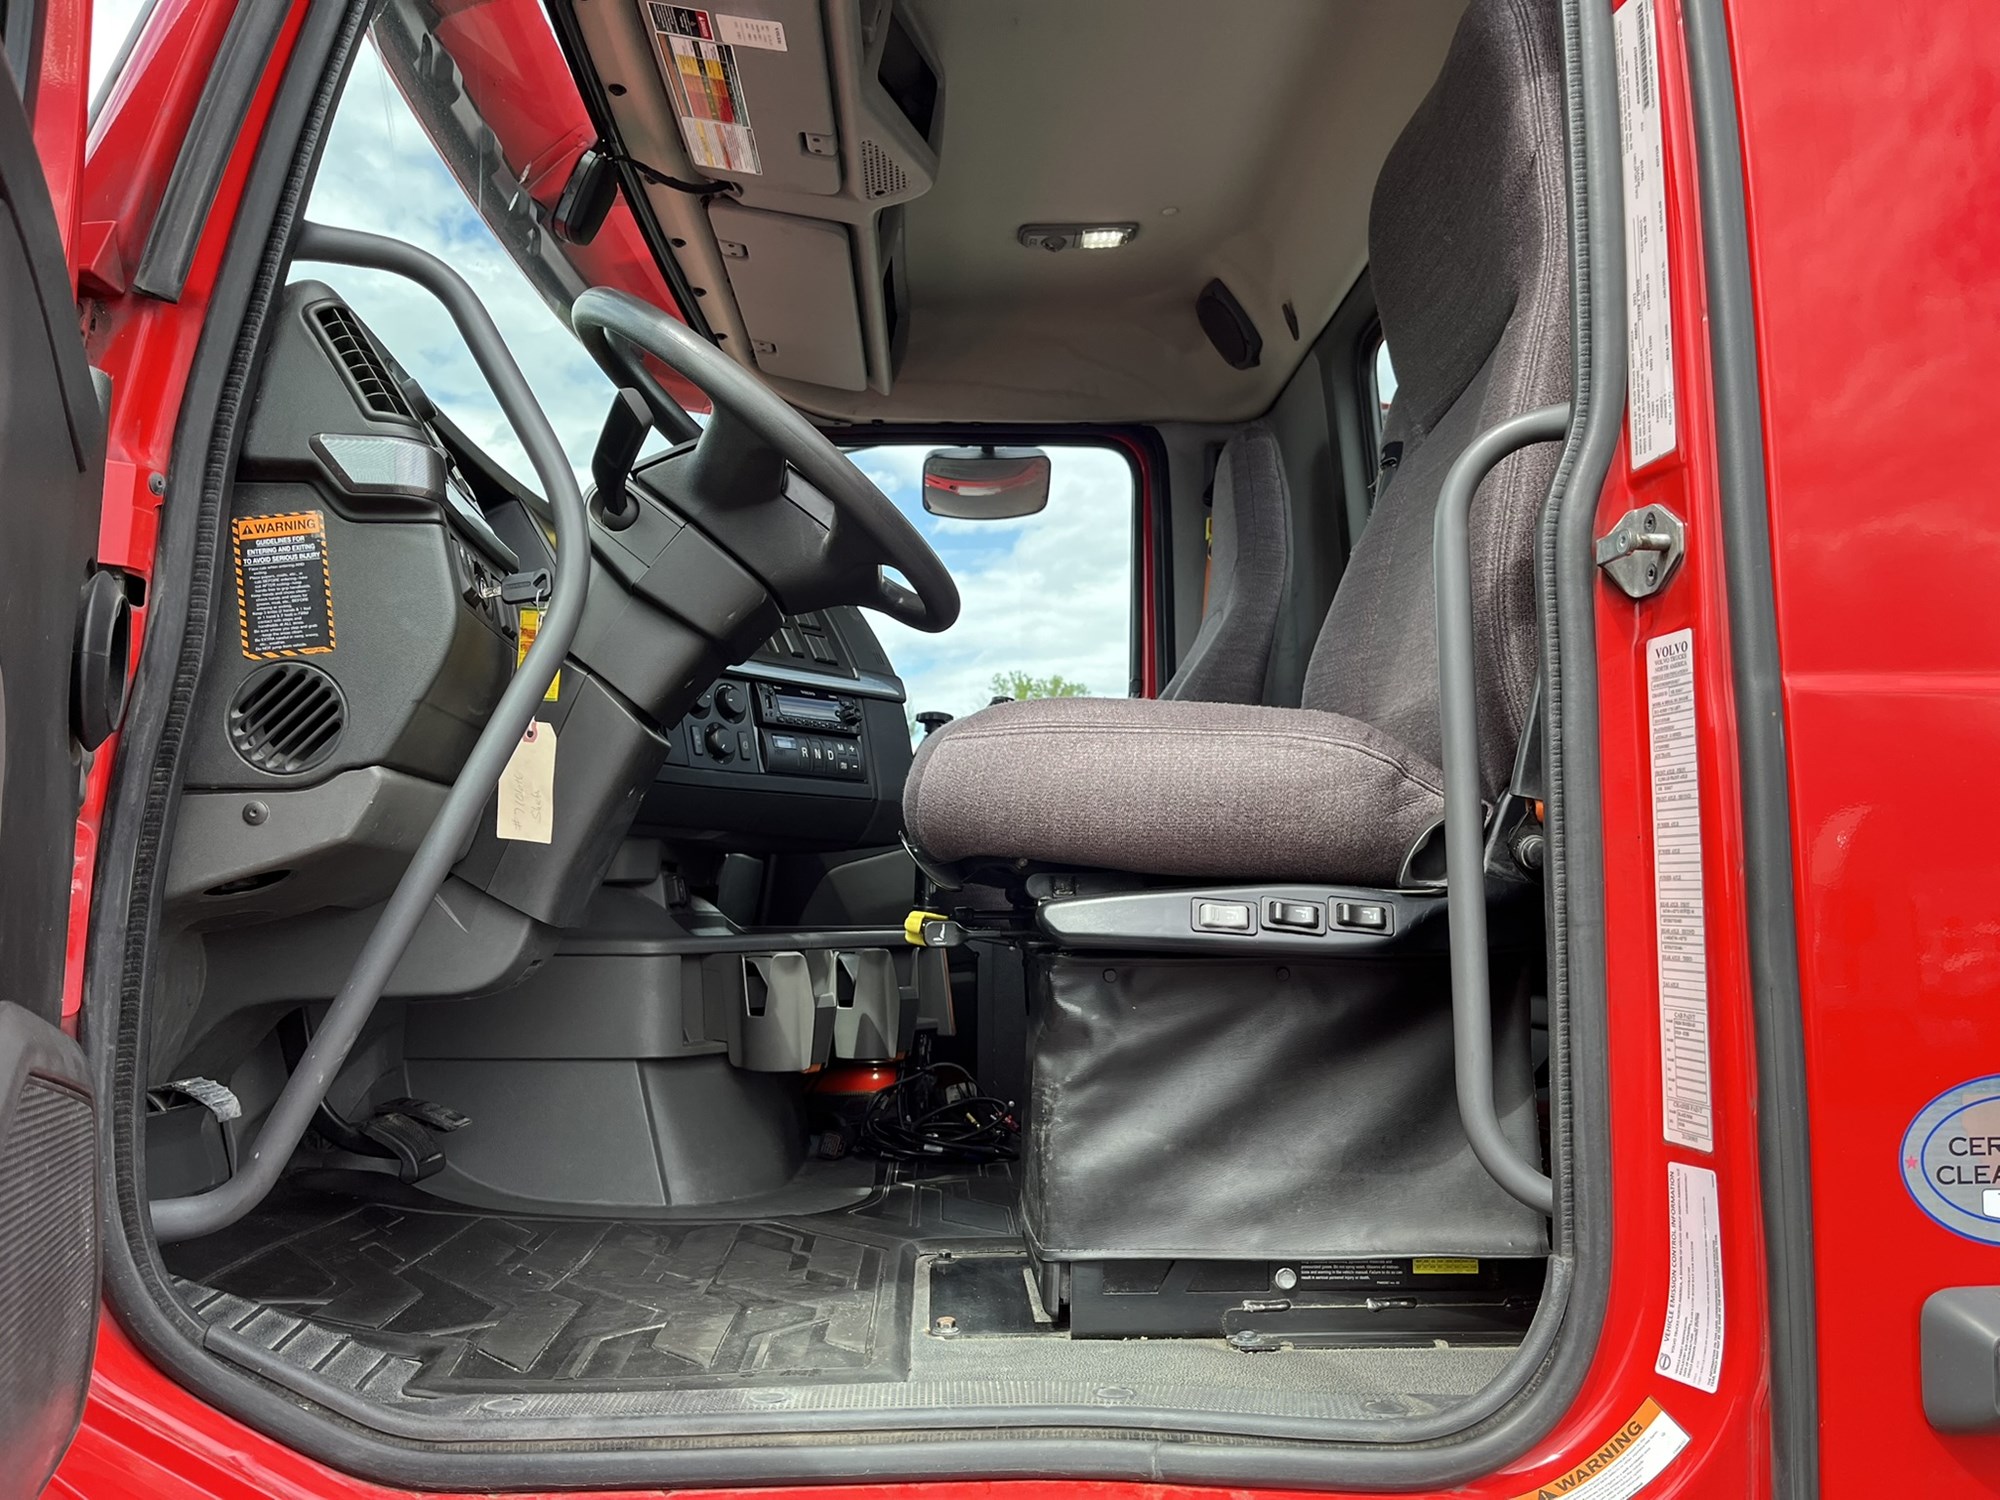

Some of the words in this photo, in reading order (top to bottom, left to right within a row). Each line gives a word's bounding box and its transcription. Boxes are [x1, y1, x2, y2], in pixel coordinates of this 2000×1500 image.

[255, 518, 316, 534] WARNING
[256, 536, 291, 547] GUIDELINES
[292, 535, 305, 543] FOR
[247, 546, 277, 556] ENTERING
[278, 545, 291, 553] AND
[292, 543, 316, 552] EXITING
[253, 556, 271, 564] AVOID
[272, 554, 298, 562] SERIOUS
[299, 551, 320, 560] INJURY
[1655, 641, 1688, 659] VOLVO
[801, 746, 809, 758] R
[814, 748, 822, 760] N
[827, 749, 834, 760] D
[1948, 1136, 2000, 1157] CER
[1664, 1311, 1675, 1342] VEHICLE
[1554, 1420, 1644, 1492] WARNING
